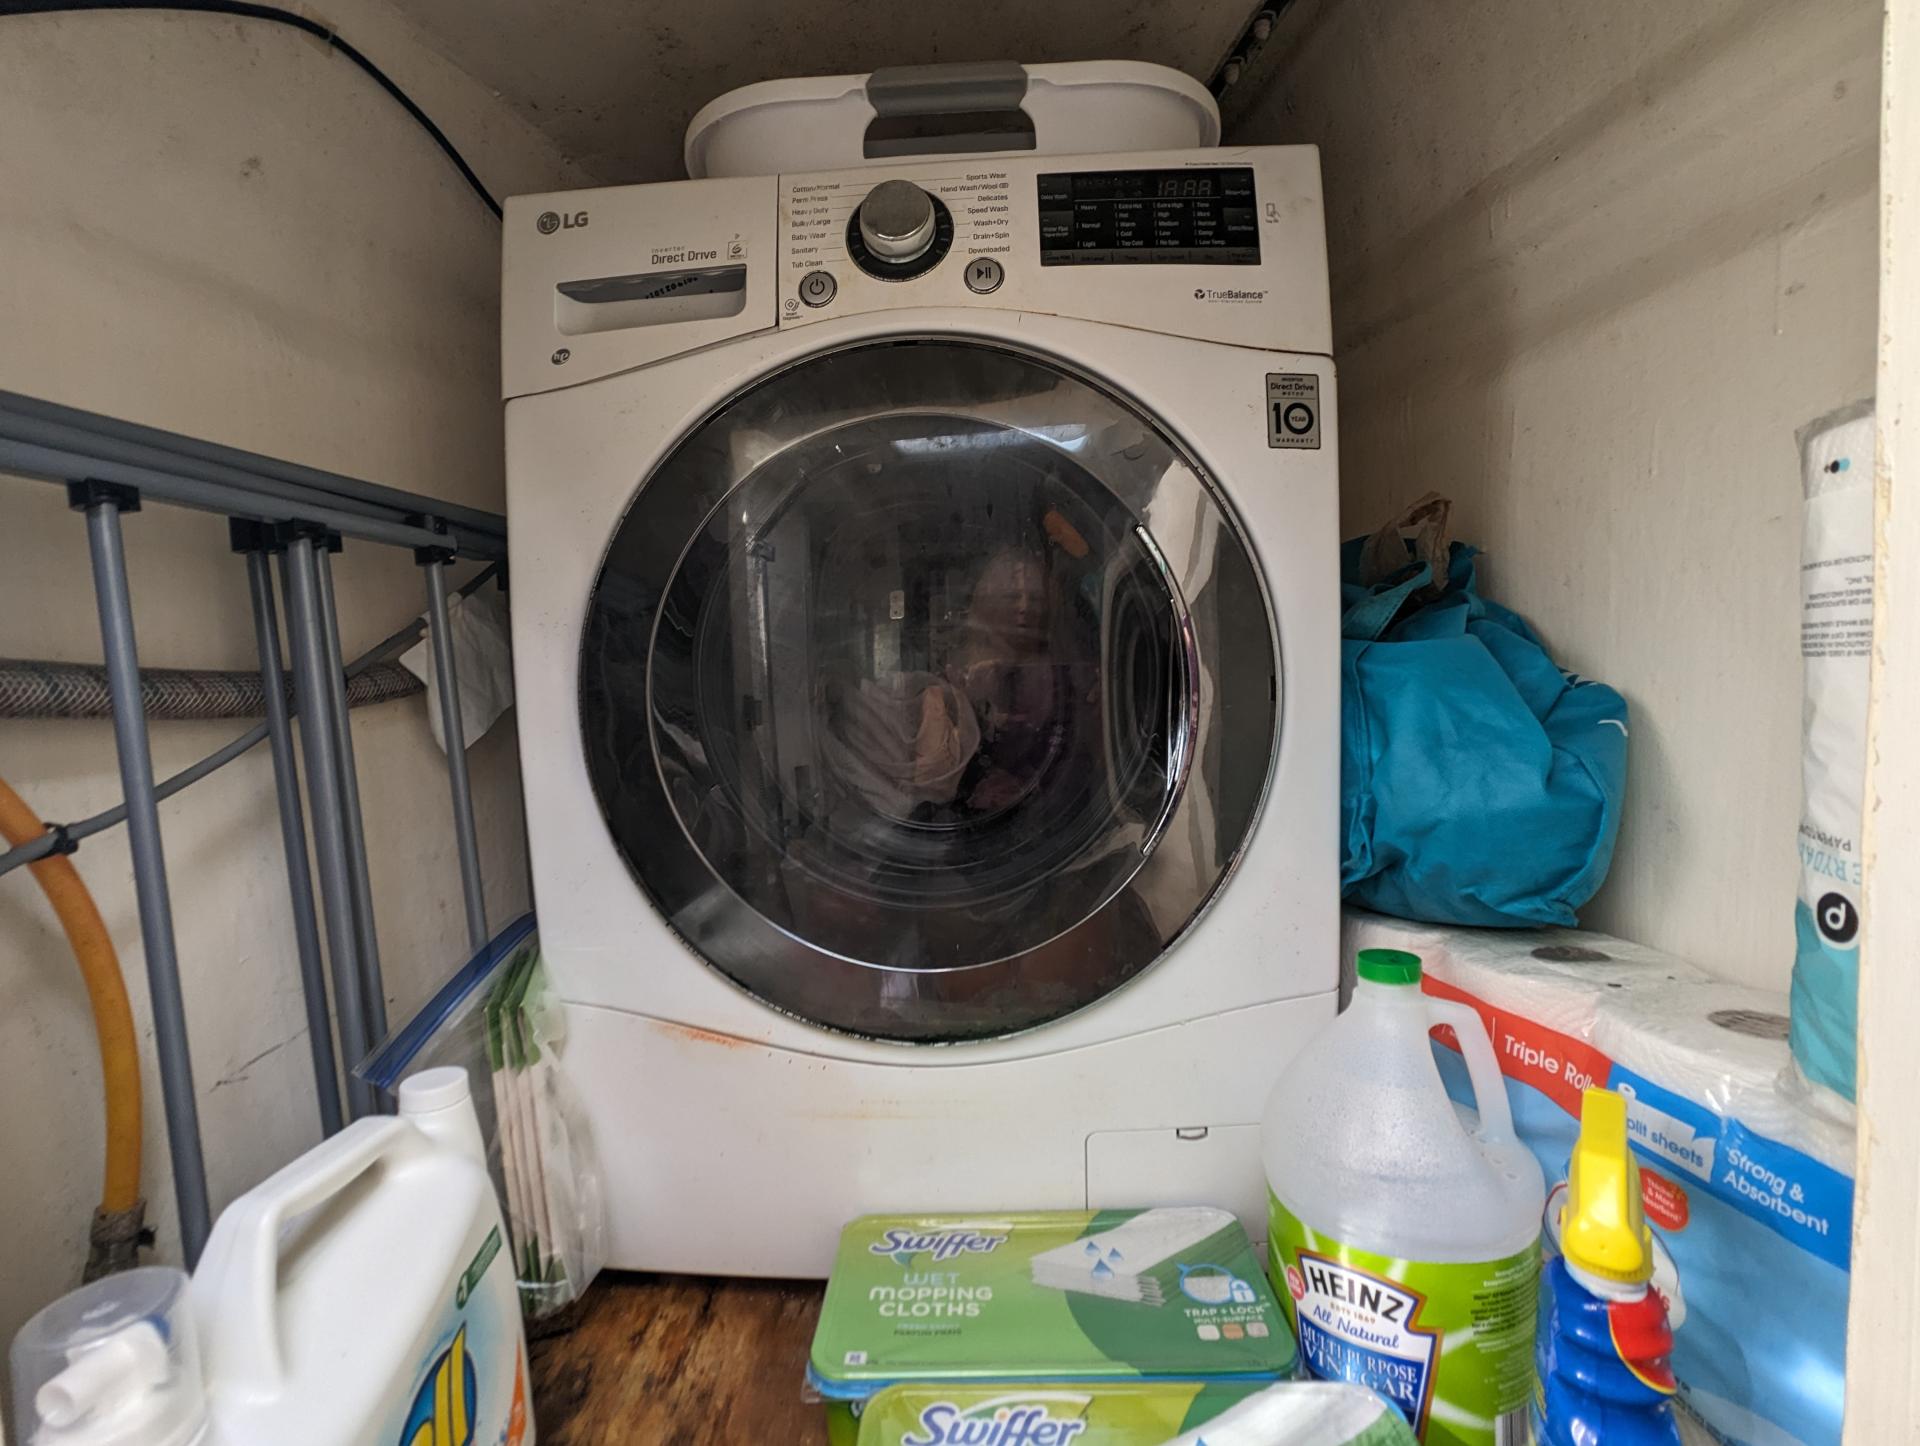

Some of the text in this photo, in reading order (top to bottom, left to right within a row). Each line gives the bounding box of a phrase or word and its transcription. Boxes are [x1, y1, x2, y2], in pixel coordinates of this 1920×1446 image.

[792, 184, 840, 193] Cotton/Normal
[563, 211, 589, 229] LG
[792, 219, 830, 228] Bulky/Large
[974, 218, 1008, 226] Wash+Dry
[809, 232, 826, 240] Wear
[973, 232, 1010, 240] Drain+Spin
[651, 253, 685, 264] Direct
[688, 250, 717, 262] Drive
[792, 247, 819, 255] Sanitary
[968, 246, 1011, 254] Downloaded
[1270, 382, 1314, 391] Direct Drive
[1272, 402, 1314, 435] 10
[1504, 1034, 1596, 1092] Triple Roll
[1652, 1131, 1704, 1168] sheets
[1727, 1148, 1804, 1204] Strong &
[1722, 1169, 1830, 1236] Absorbent
[870, 1230, 1005, 1260] Swiffer
[903, 1272, 960, 1285] WET
[869, 1286, 993, 1301] MOPPING
[1309, 1265, 1404, 1323] HEINZ
[879, 1302, 980, 1318] CLOTHS
[1184, 1308, 1217, 1318] TRAP
[1313, 1304, 1400, 1348] All Natural
[1304, 1340, 1416, 1402] VINEGAR
[903, 1405, 1082, 1446] Swiffer
